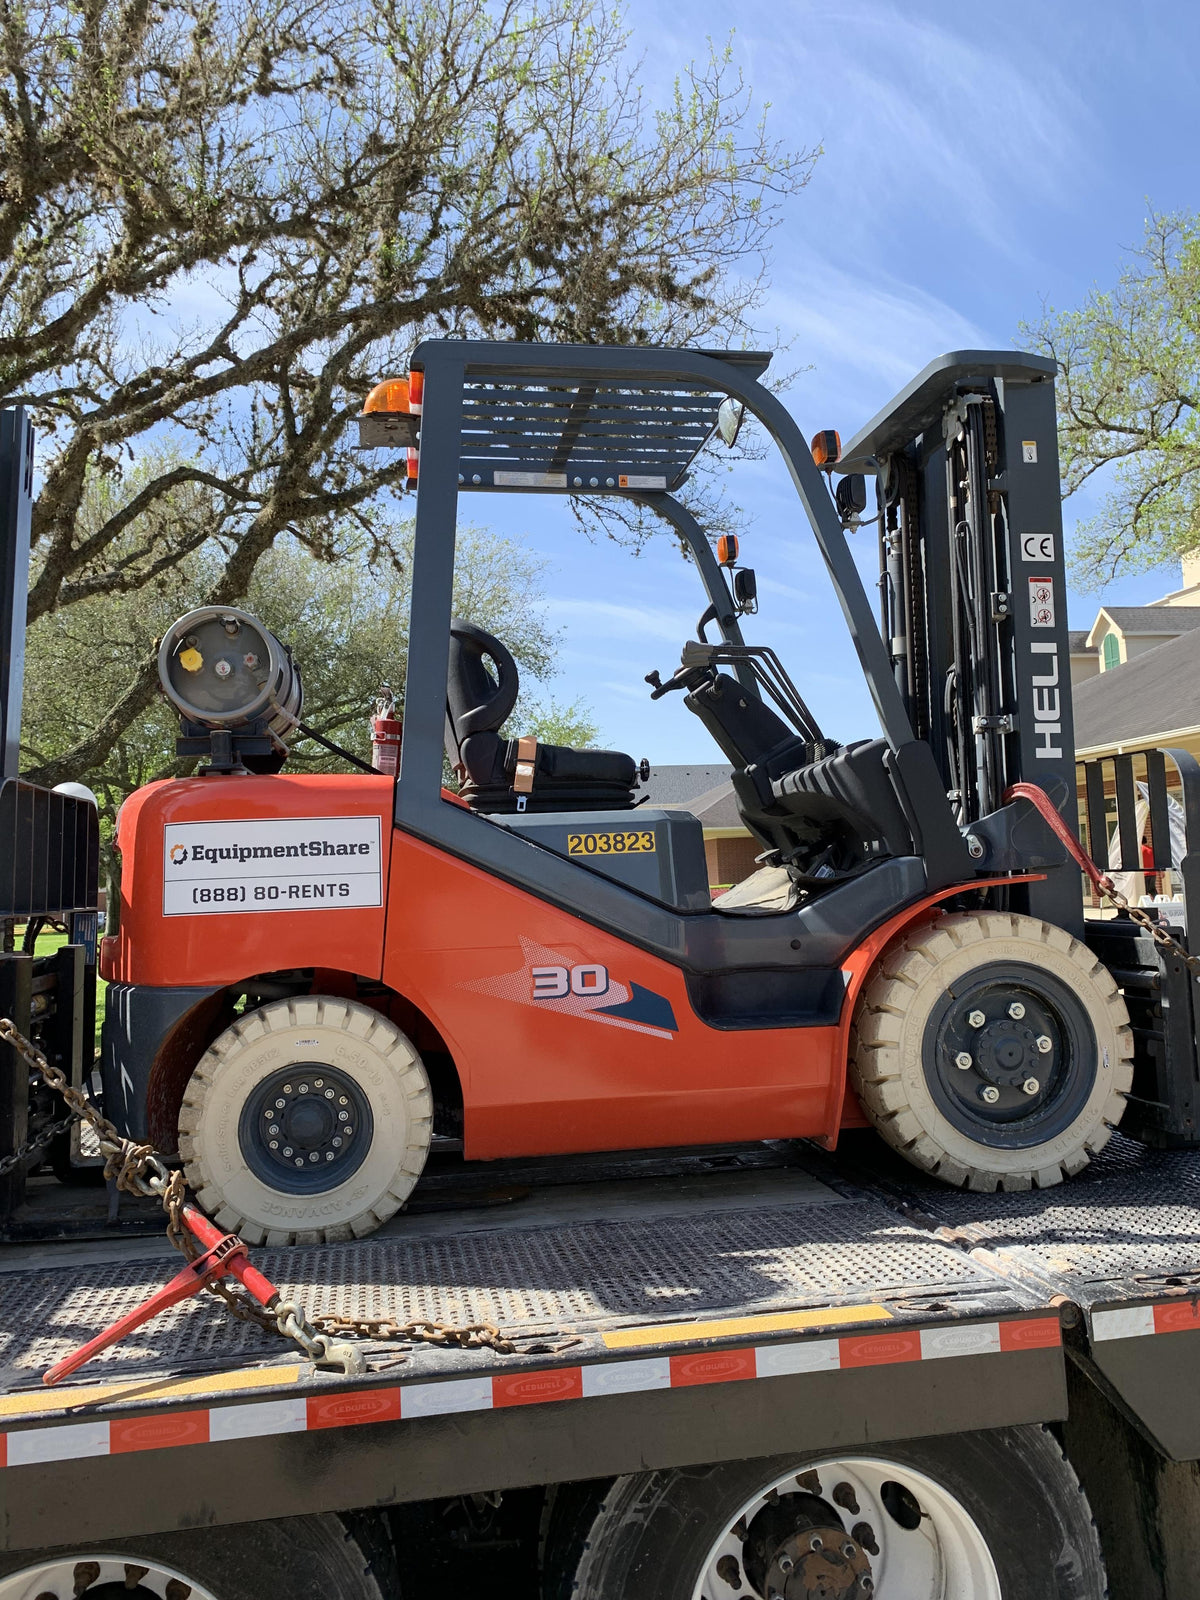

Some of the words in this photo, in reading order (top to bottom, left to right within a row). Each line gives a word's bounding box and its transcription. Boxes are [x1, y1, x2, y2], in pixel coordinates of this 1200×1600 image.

[1024, 537, 1052, 558] CE
[1030, 642, 1063, 758] HELI
[191, 841, 370, 863] EquipmentShare
[569, 832, 654, 854] 203823
[192, 886, 246, 904] (888)
[253, 883, 350, 900] 80-RENTS
[532, 964, 609, 1000] 30
[520, 1381, 561, 1392] LEDWELL
[334, 1402, 377, 1414] LEDWELL
